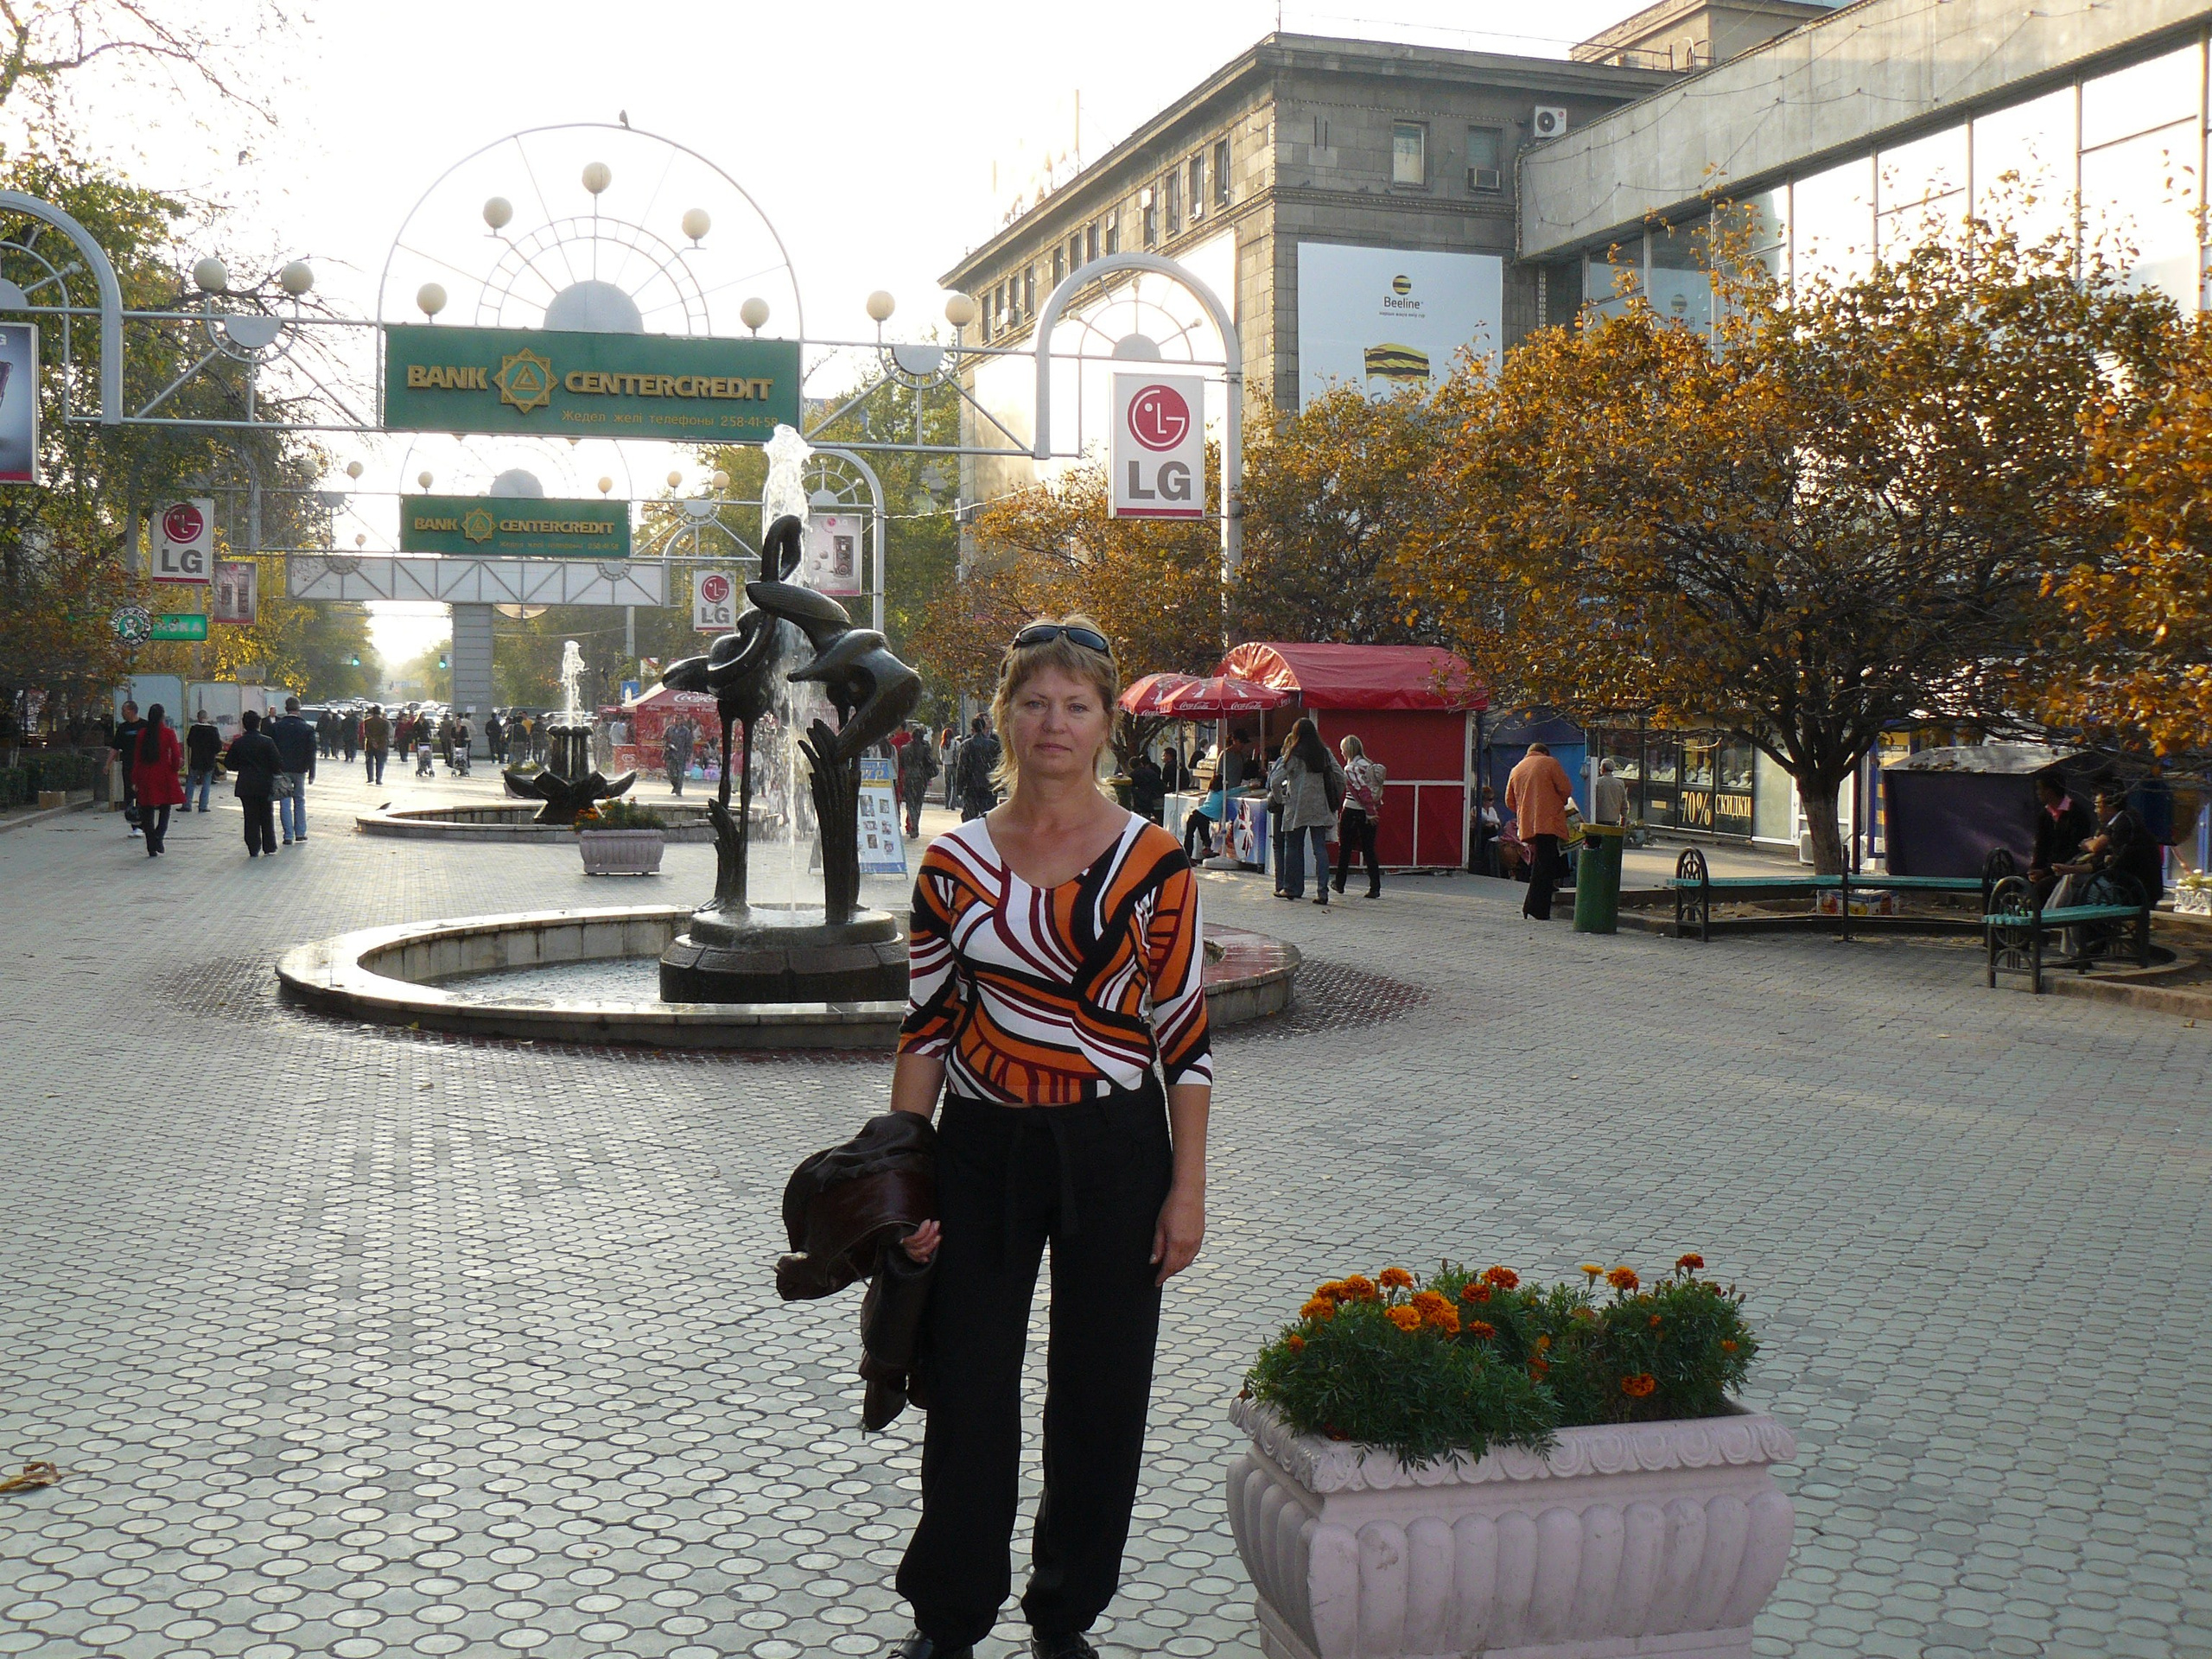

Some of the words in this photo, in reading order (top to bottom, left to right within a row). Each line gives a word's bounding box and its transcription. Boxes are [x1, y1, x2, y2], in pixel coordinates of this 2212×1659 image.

[1383, 296, 1421, 309] Beeline
[407, 365, 487, 390] BANK
[564, 371, 773, 401] CENTERCREDIT
[562, 410, 606, 423] Жедел
[613, 412, 642, 423] желі
[650, 414, 715, 428] телефоны
[721, 415, 778, 428] 258-41-58
[1128, 461, 1191, 501] LG
[415, 518, 458, 531] BANK
[499, 519, 614, 534] CENTERCREDIT
[162, 549, 203, 574] LG
[701, 607, 730, 624] LG
[1230, 701, 1262, 709] Coca-Cola
[1681, 791, 1711, 826] 70%
[1715, 793, 1752, 820] СКИДКИ
